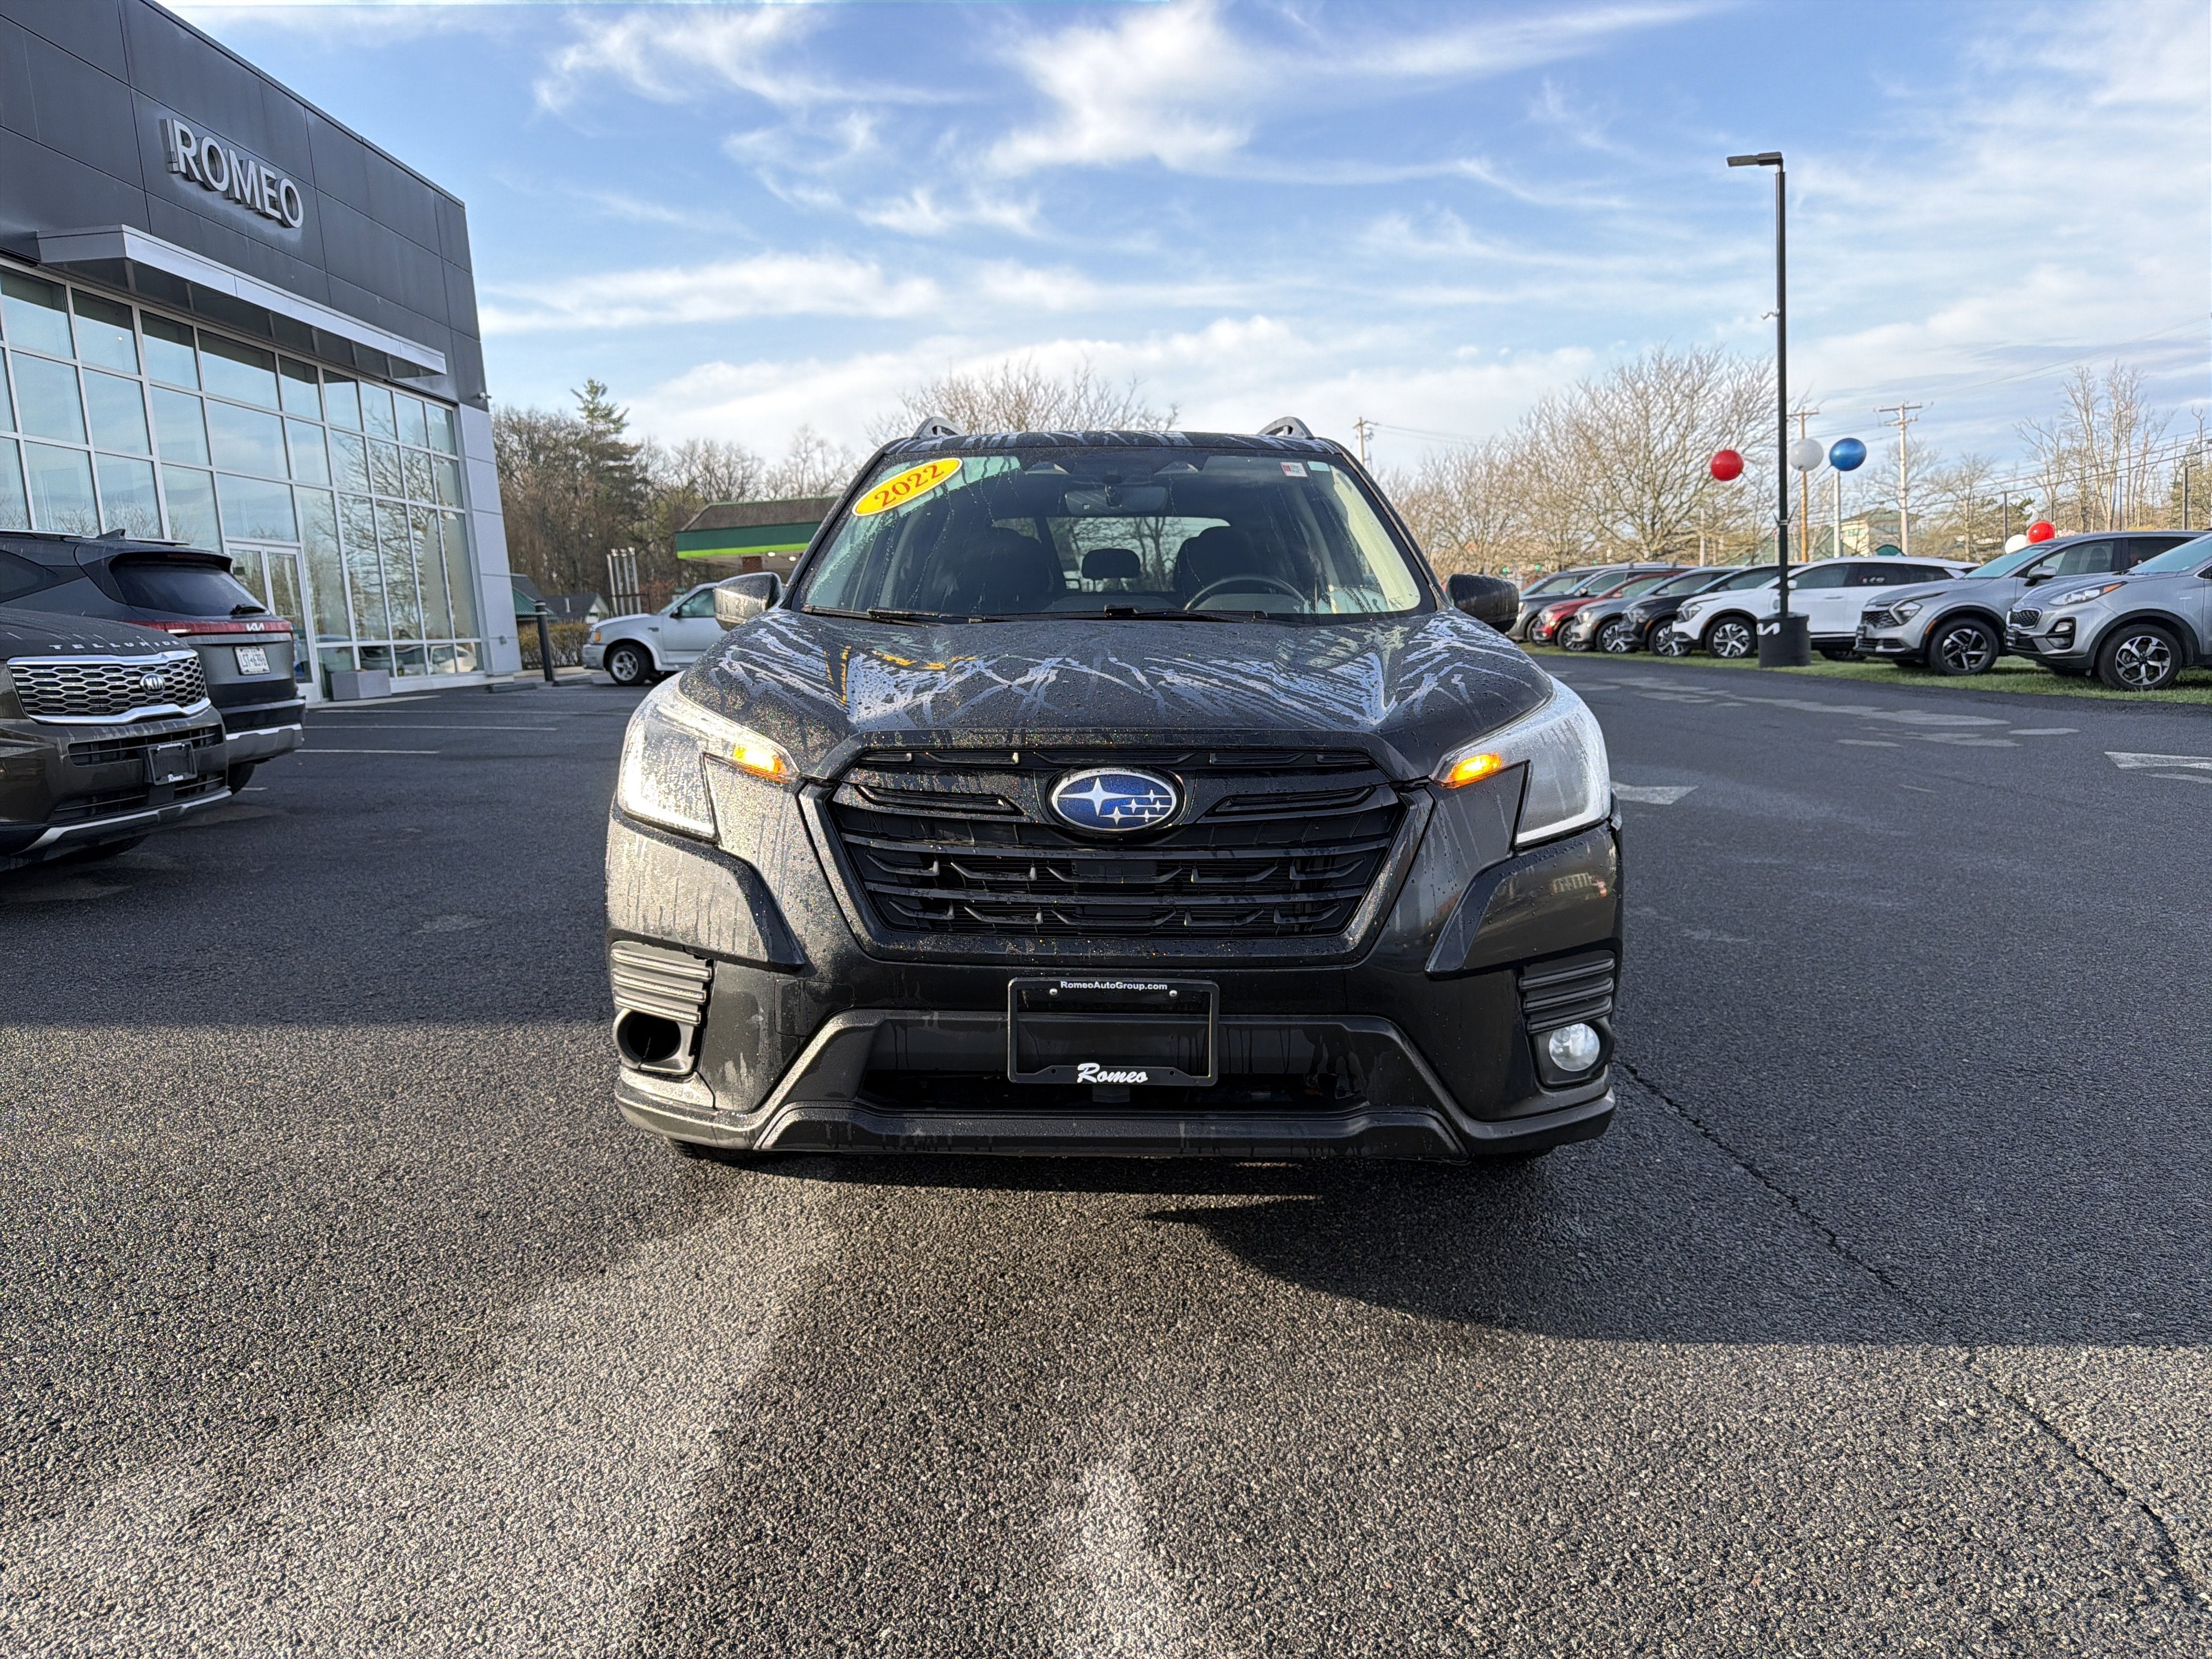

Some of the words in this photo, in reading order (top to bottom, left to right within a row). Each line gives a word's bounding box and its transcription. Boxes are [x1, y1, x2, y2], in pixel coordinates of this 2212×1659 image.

[166, 119, 303, 228] ROMEO
[874, 464, 945, 507] 2022
[144, 677, 165, 690] KIA
[1060, 980, 1168, 991] RomeoAutoGroup.com
[1077, 1063, 1148, 1084] Romeo
